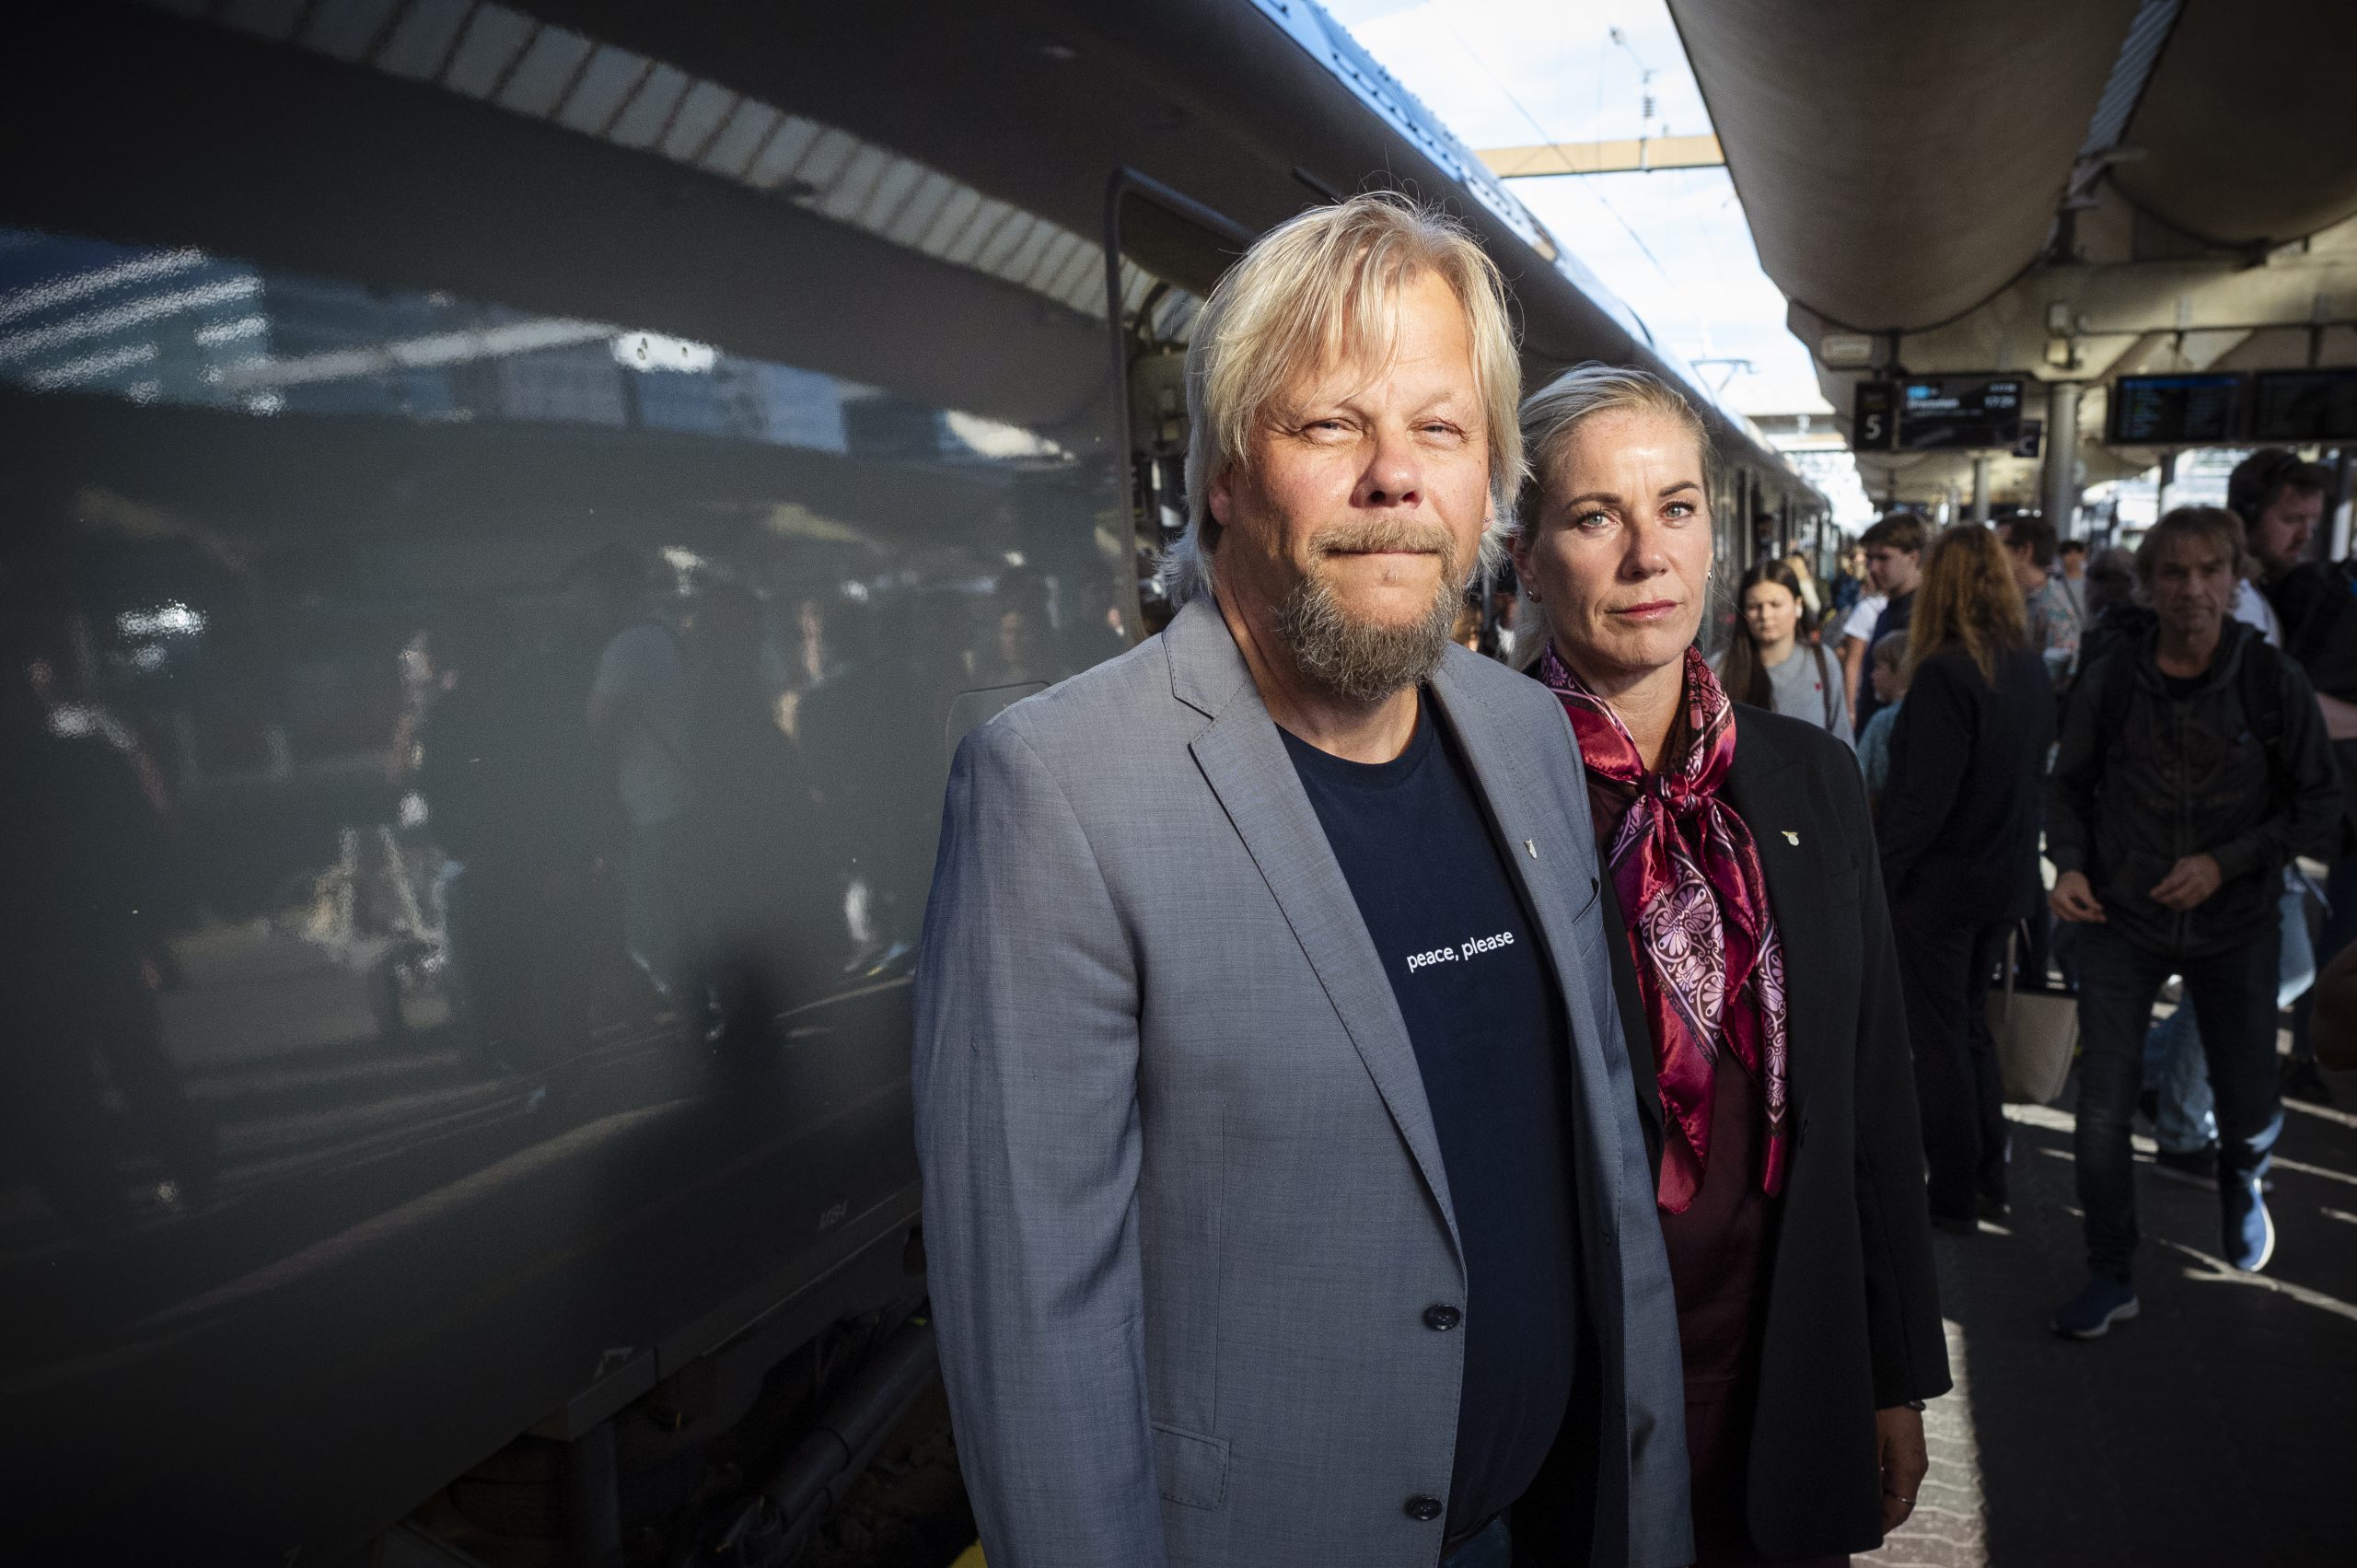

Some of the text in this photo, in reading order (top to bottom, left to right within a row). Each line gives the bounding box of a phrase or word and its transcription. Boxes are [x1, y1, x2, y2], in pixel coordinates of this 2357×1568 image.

[1864, 413, 1882, 440] 5
[1406, 931, 1515, 973] peace, please
